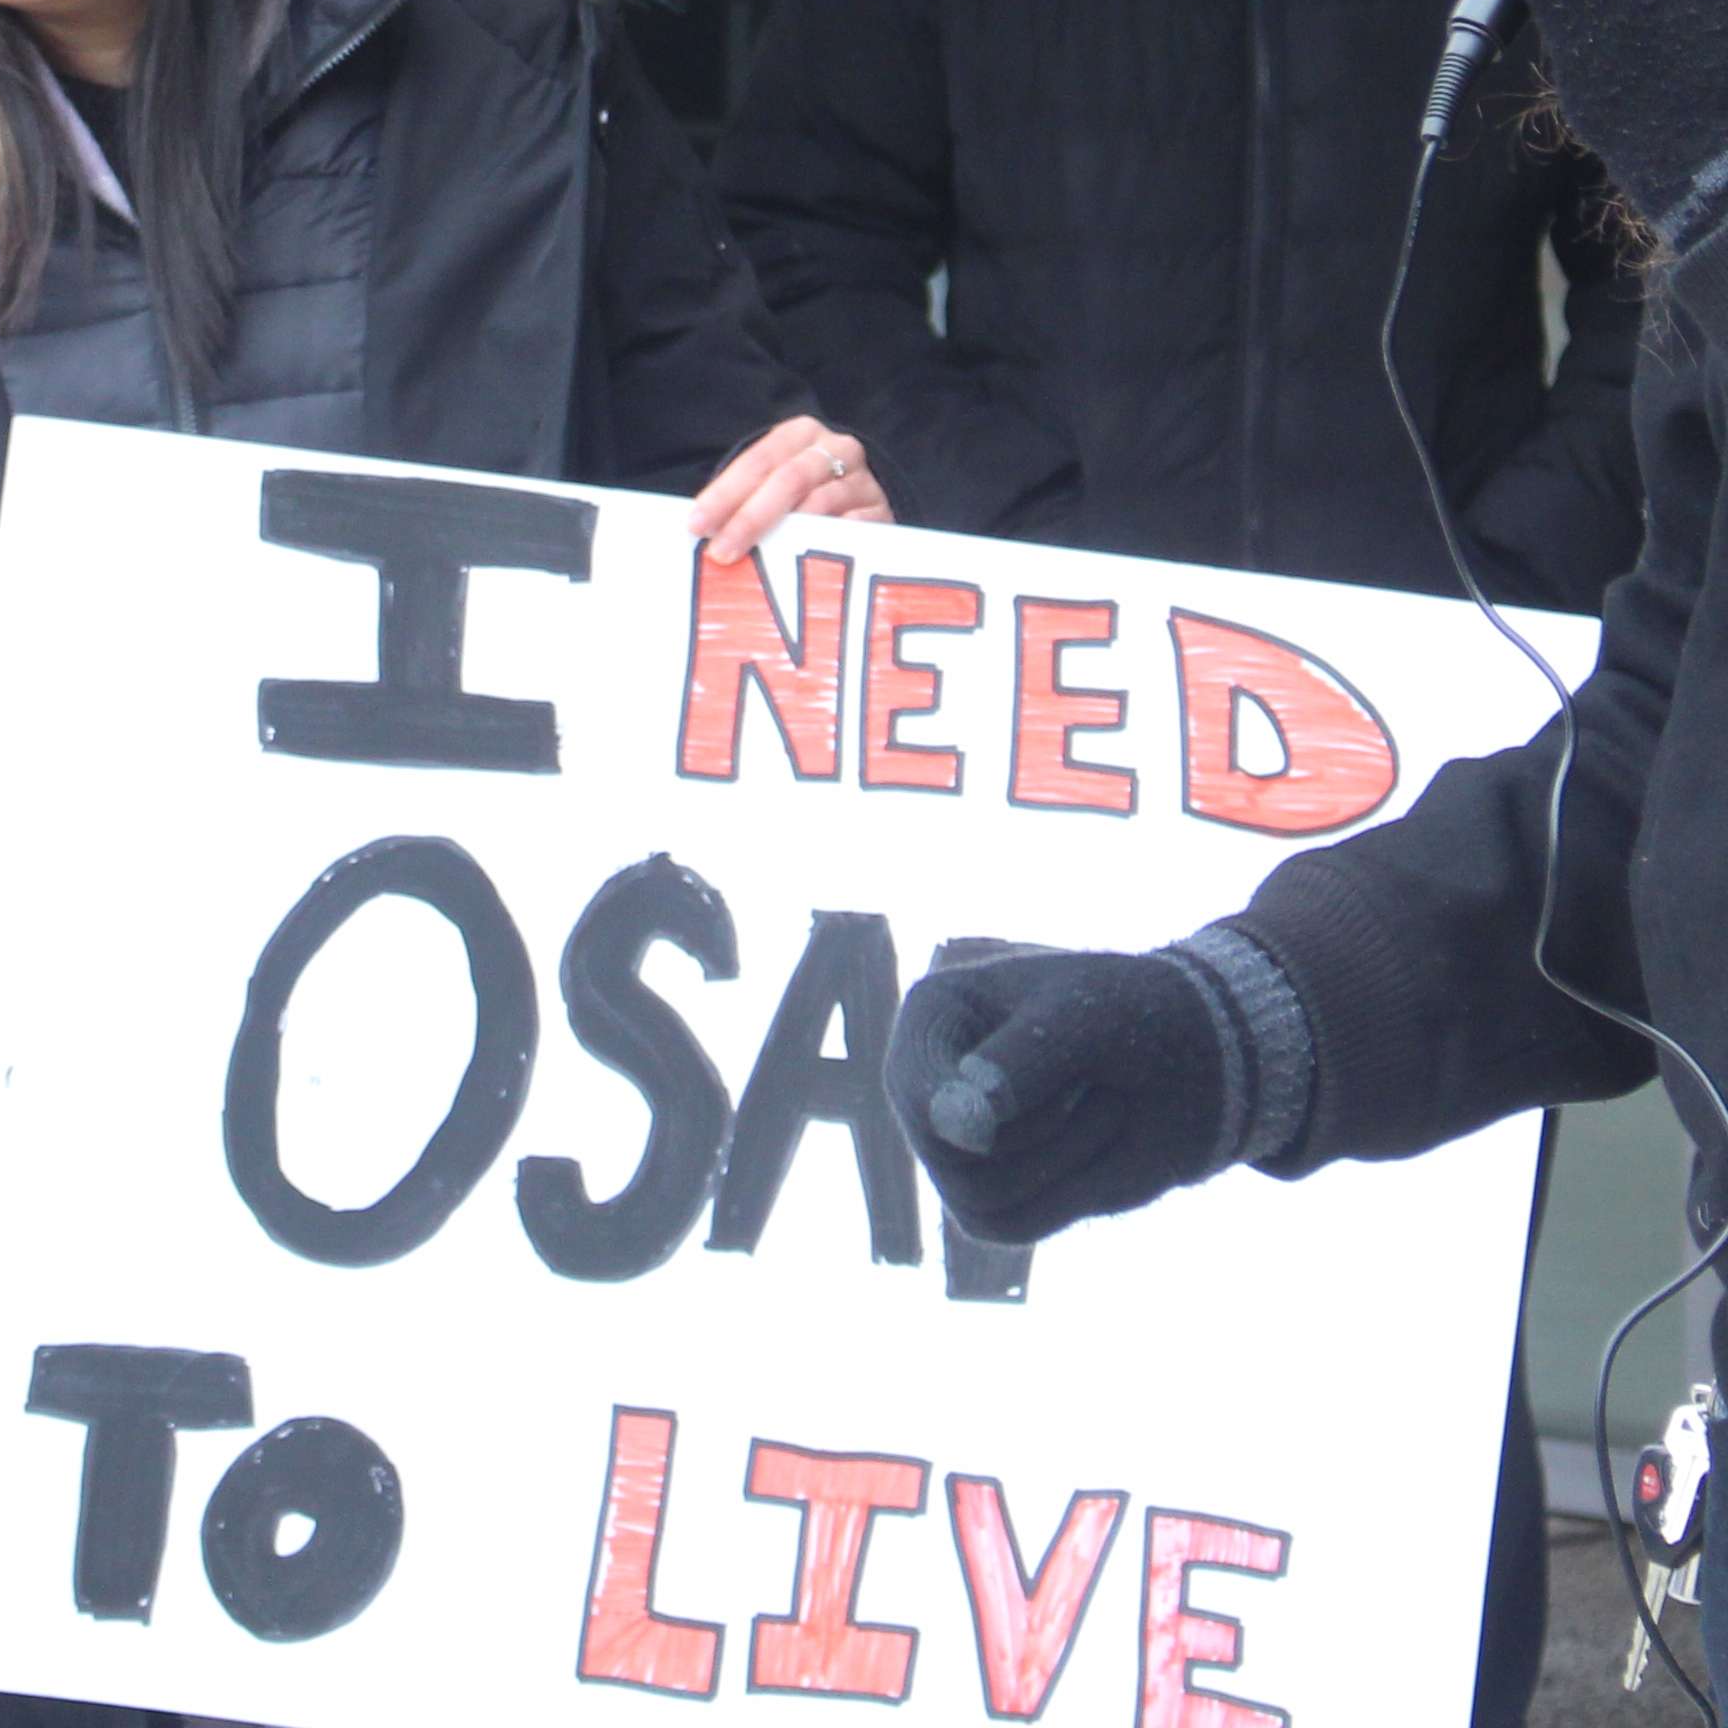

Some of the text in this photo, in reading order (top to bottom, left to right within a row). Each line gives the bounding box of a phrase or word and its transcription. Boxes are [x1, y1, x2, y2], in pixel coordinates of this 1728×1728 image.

[256, 469, 1400, 838] I NEED
[25, 1342, 1293, 1728] TO LIVE
